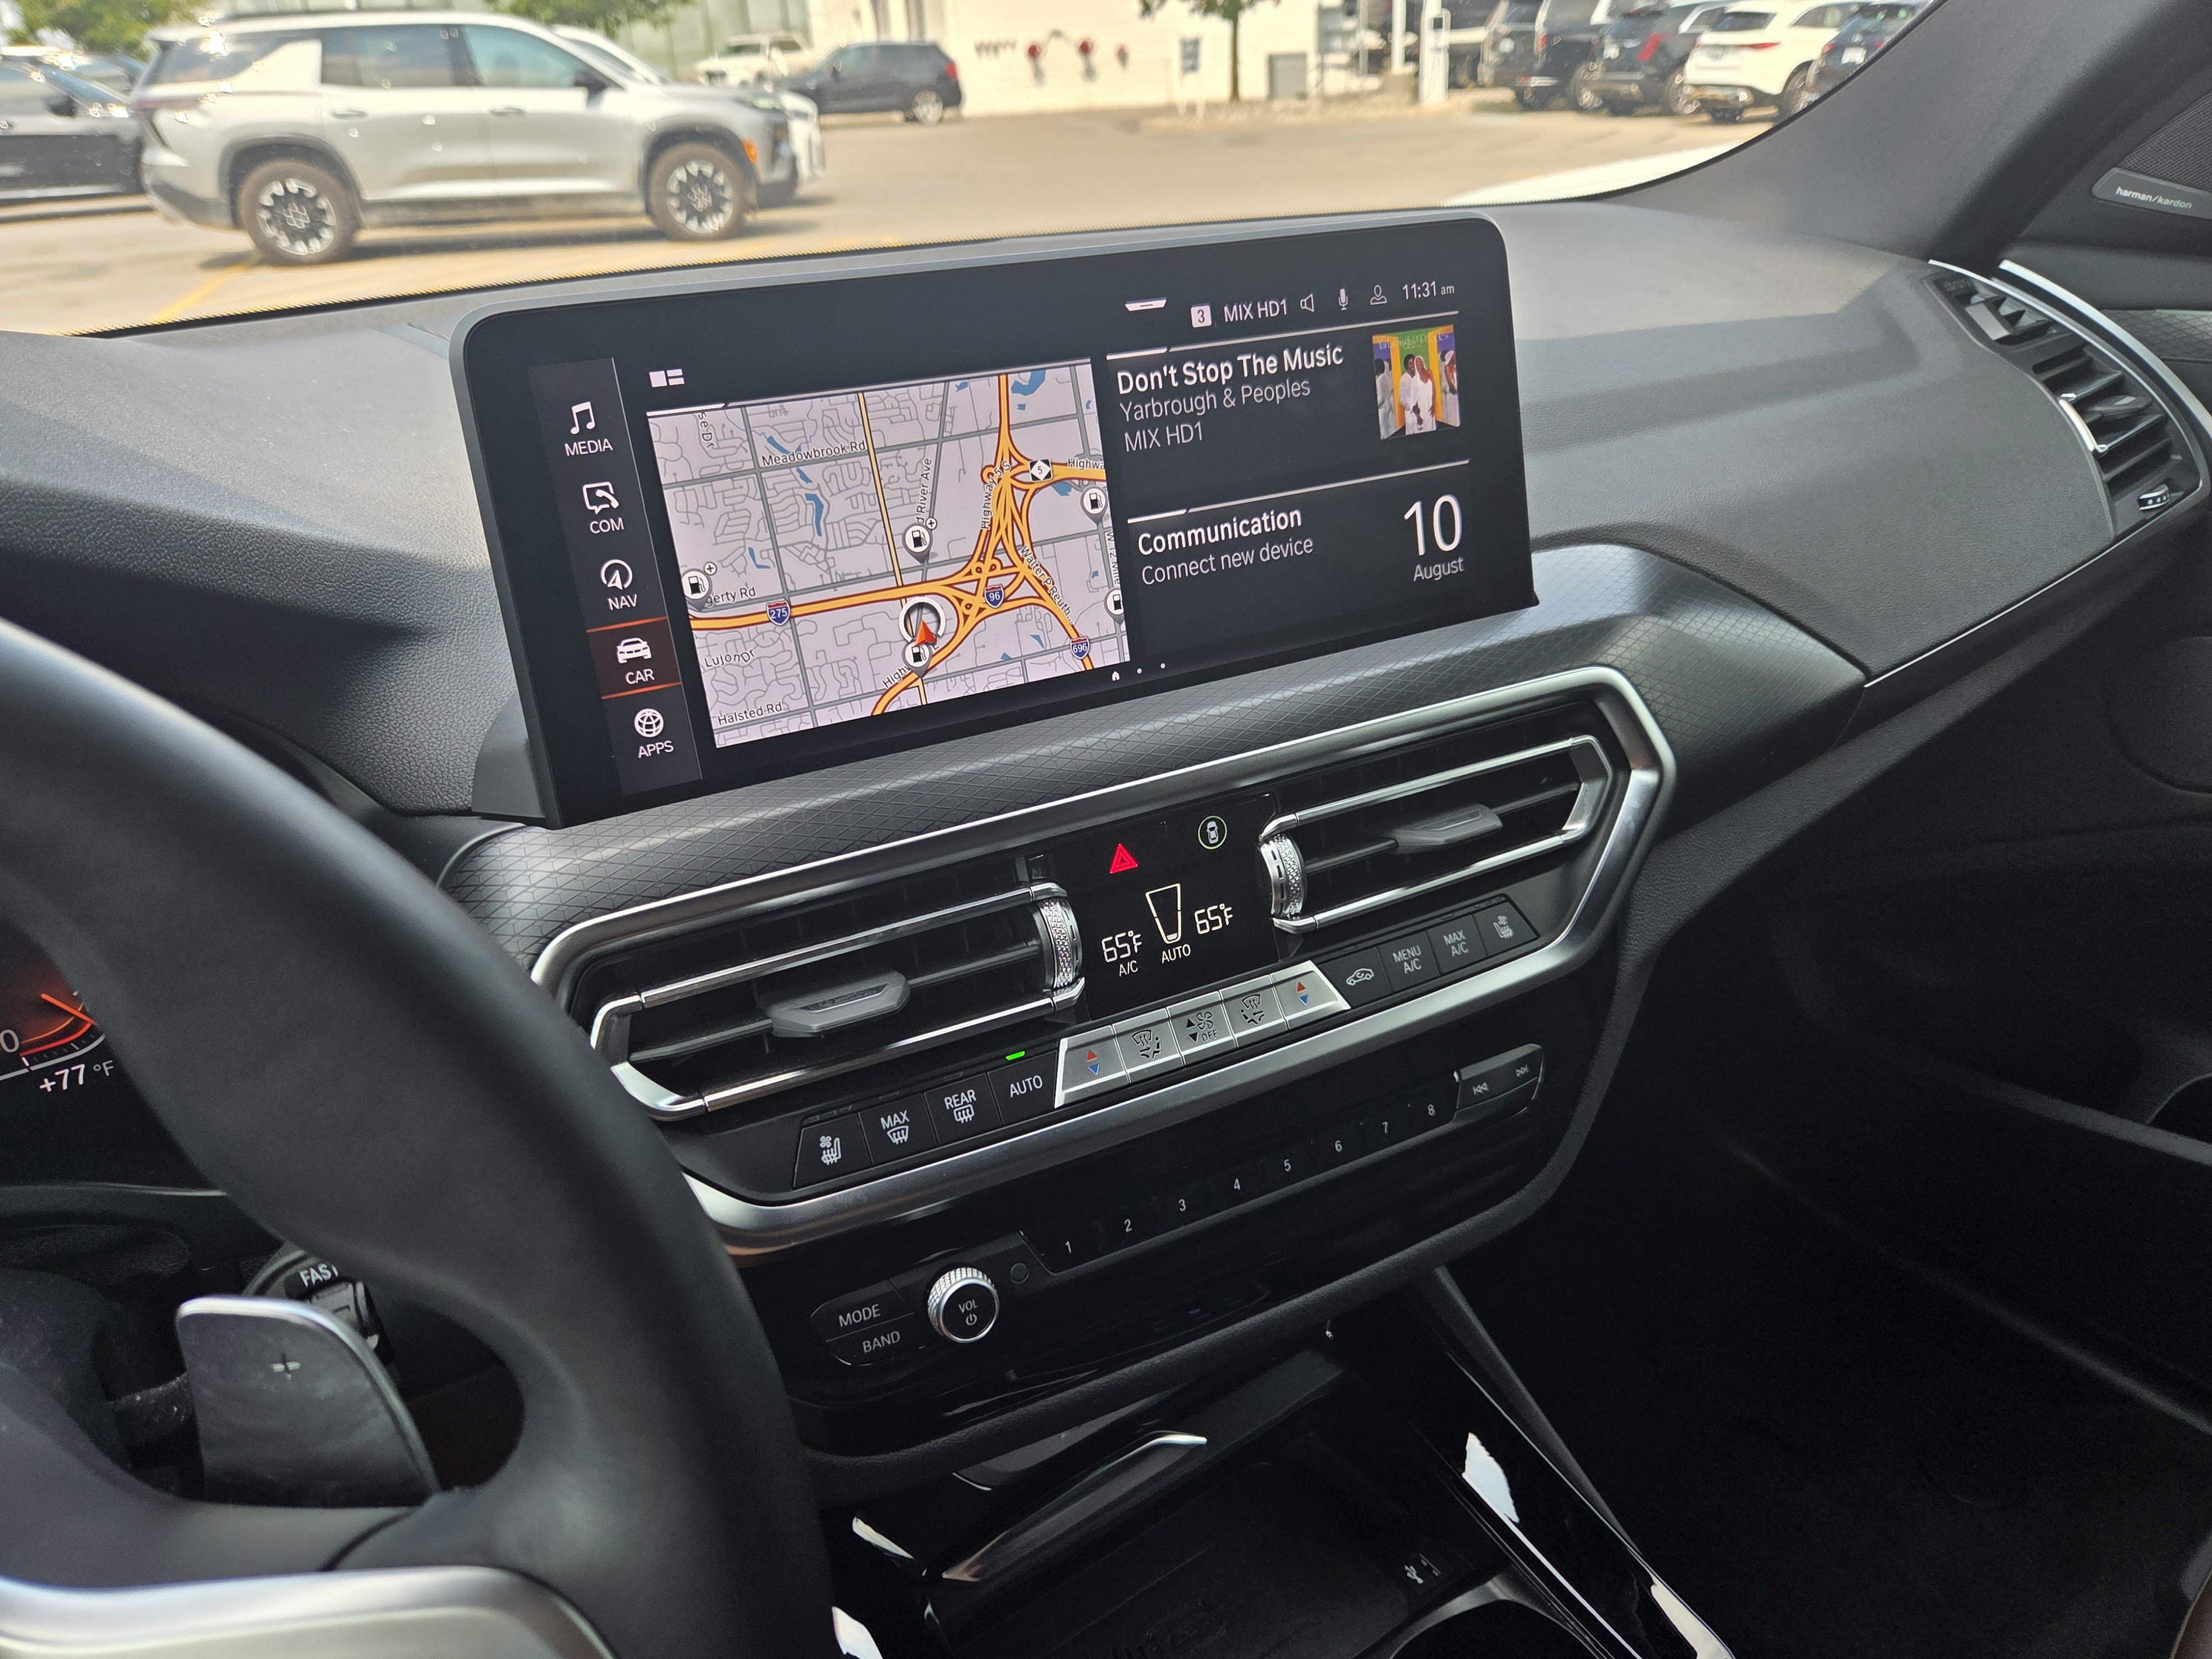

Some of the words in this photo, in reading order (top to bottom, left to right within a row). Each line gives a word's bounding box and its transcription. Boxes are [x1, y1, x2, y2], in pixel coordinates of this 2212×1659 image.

[2116, 186, 2193, 209] harman/kardon
[1402, 281, 1437, 300] 11:31
[1441, 285, 1454, 295] am
[1197, 309, 1205, 323] 3
[1224, 304, 1254, 322] MIX
[1258, 299, 1287, 318] HD1
[1117, 364, 1179, 394] Don't
[1183, 357, 1233, 387] Stop
[1237, 352, 1278, 378] The
[1284, 345, 1344, 371] Music
[1120, 391, 1218, 423] Yarbrough
[1223, 388, 1237, 406] &
[1241, 378, 1311, 404] Peoples
[702, 432, 714, 448] Dr
[1124, 431, 1161, 452] MIX
[1166, 421, 1203, 445] HD1
[565, 439, 613, 456] MEDIA
[761, 444, 848, 466] Meadowbrook
[850, 440, 866, 452] Rd
[921, 458, 932, 481] Ave
[1037, 466, 1042, 474] 5
[916, 483, 928, 513] River
[980, 477, 997, 529] Highway
[994, 467, 1002, 477] 5
[1002, 461, 1010, 471] S
[589, 517, 624, 534] COM
[1138, 509, 1302, 556] Communication
[1404, 494, 1463, 556] 10
[1021, 545, 1045, 578] Walter
[1141, 558, 1216, 585] Connect
[1220, 549, 1254, 571] new
[1259, 538, 1314, 562] device
[1413, 557, 1464, 582] August
[739, 586, 756, 598] Rd
[989, 592, 1001, 602] 96
[607, 594, 638, 611] NAV
[770, 608, 787, 619] 275
[705, 653, 740, 667] Lujon
[740, 649, 754, 662] Dr
[1073, 643, 1087, 653] 696
[625, 668, 655, 685] CAR
[718, 706, 764, 726] Halsted
[766, 701, 782, 714] Rd
[638, 740, 674, 759] APPS
[1443, 930, 1466, 946] MAX
[1161, 944, 1191, 964] AUTO
[1392, 946, 1421, 963] MENU
[1451, 941, 1468, 957] A/C
[1118, 960, 1139, 977] A/C
[1404, 958, 1422, 974] A/C
[1202, 1029, 1217, 1041] OFF
[1009, 1075, 1044, 1098] AUTO
[944, 1089, 977, 1110] REAR
[880, 1110, 910, 1130] MAX
[1066, 1241, 1071, 1253] 1
[1125, 1219, 1131, 1232] 2
[1179, 1199, 1186, 1211] 3
[1234, 1178, 1240, 1190] 4
[1285, 1160, 1290, 1171] 5
[1335, 1140, 1342, 1152] 6
[1383, 1122, 1388, 1134] 7
[1428, 1104, 1434, 1116] 8
[838, 1303, 881, 1327] MODE
[958, 1299, 978, 1313] VOL
[862, 1331, 900, 1353] BAND
